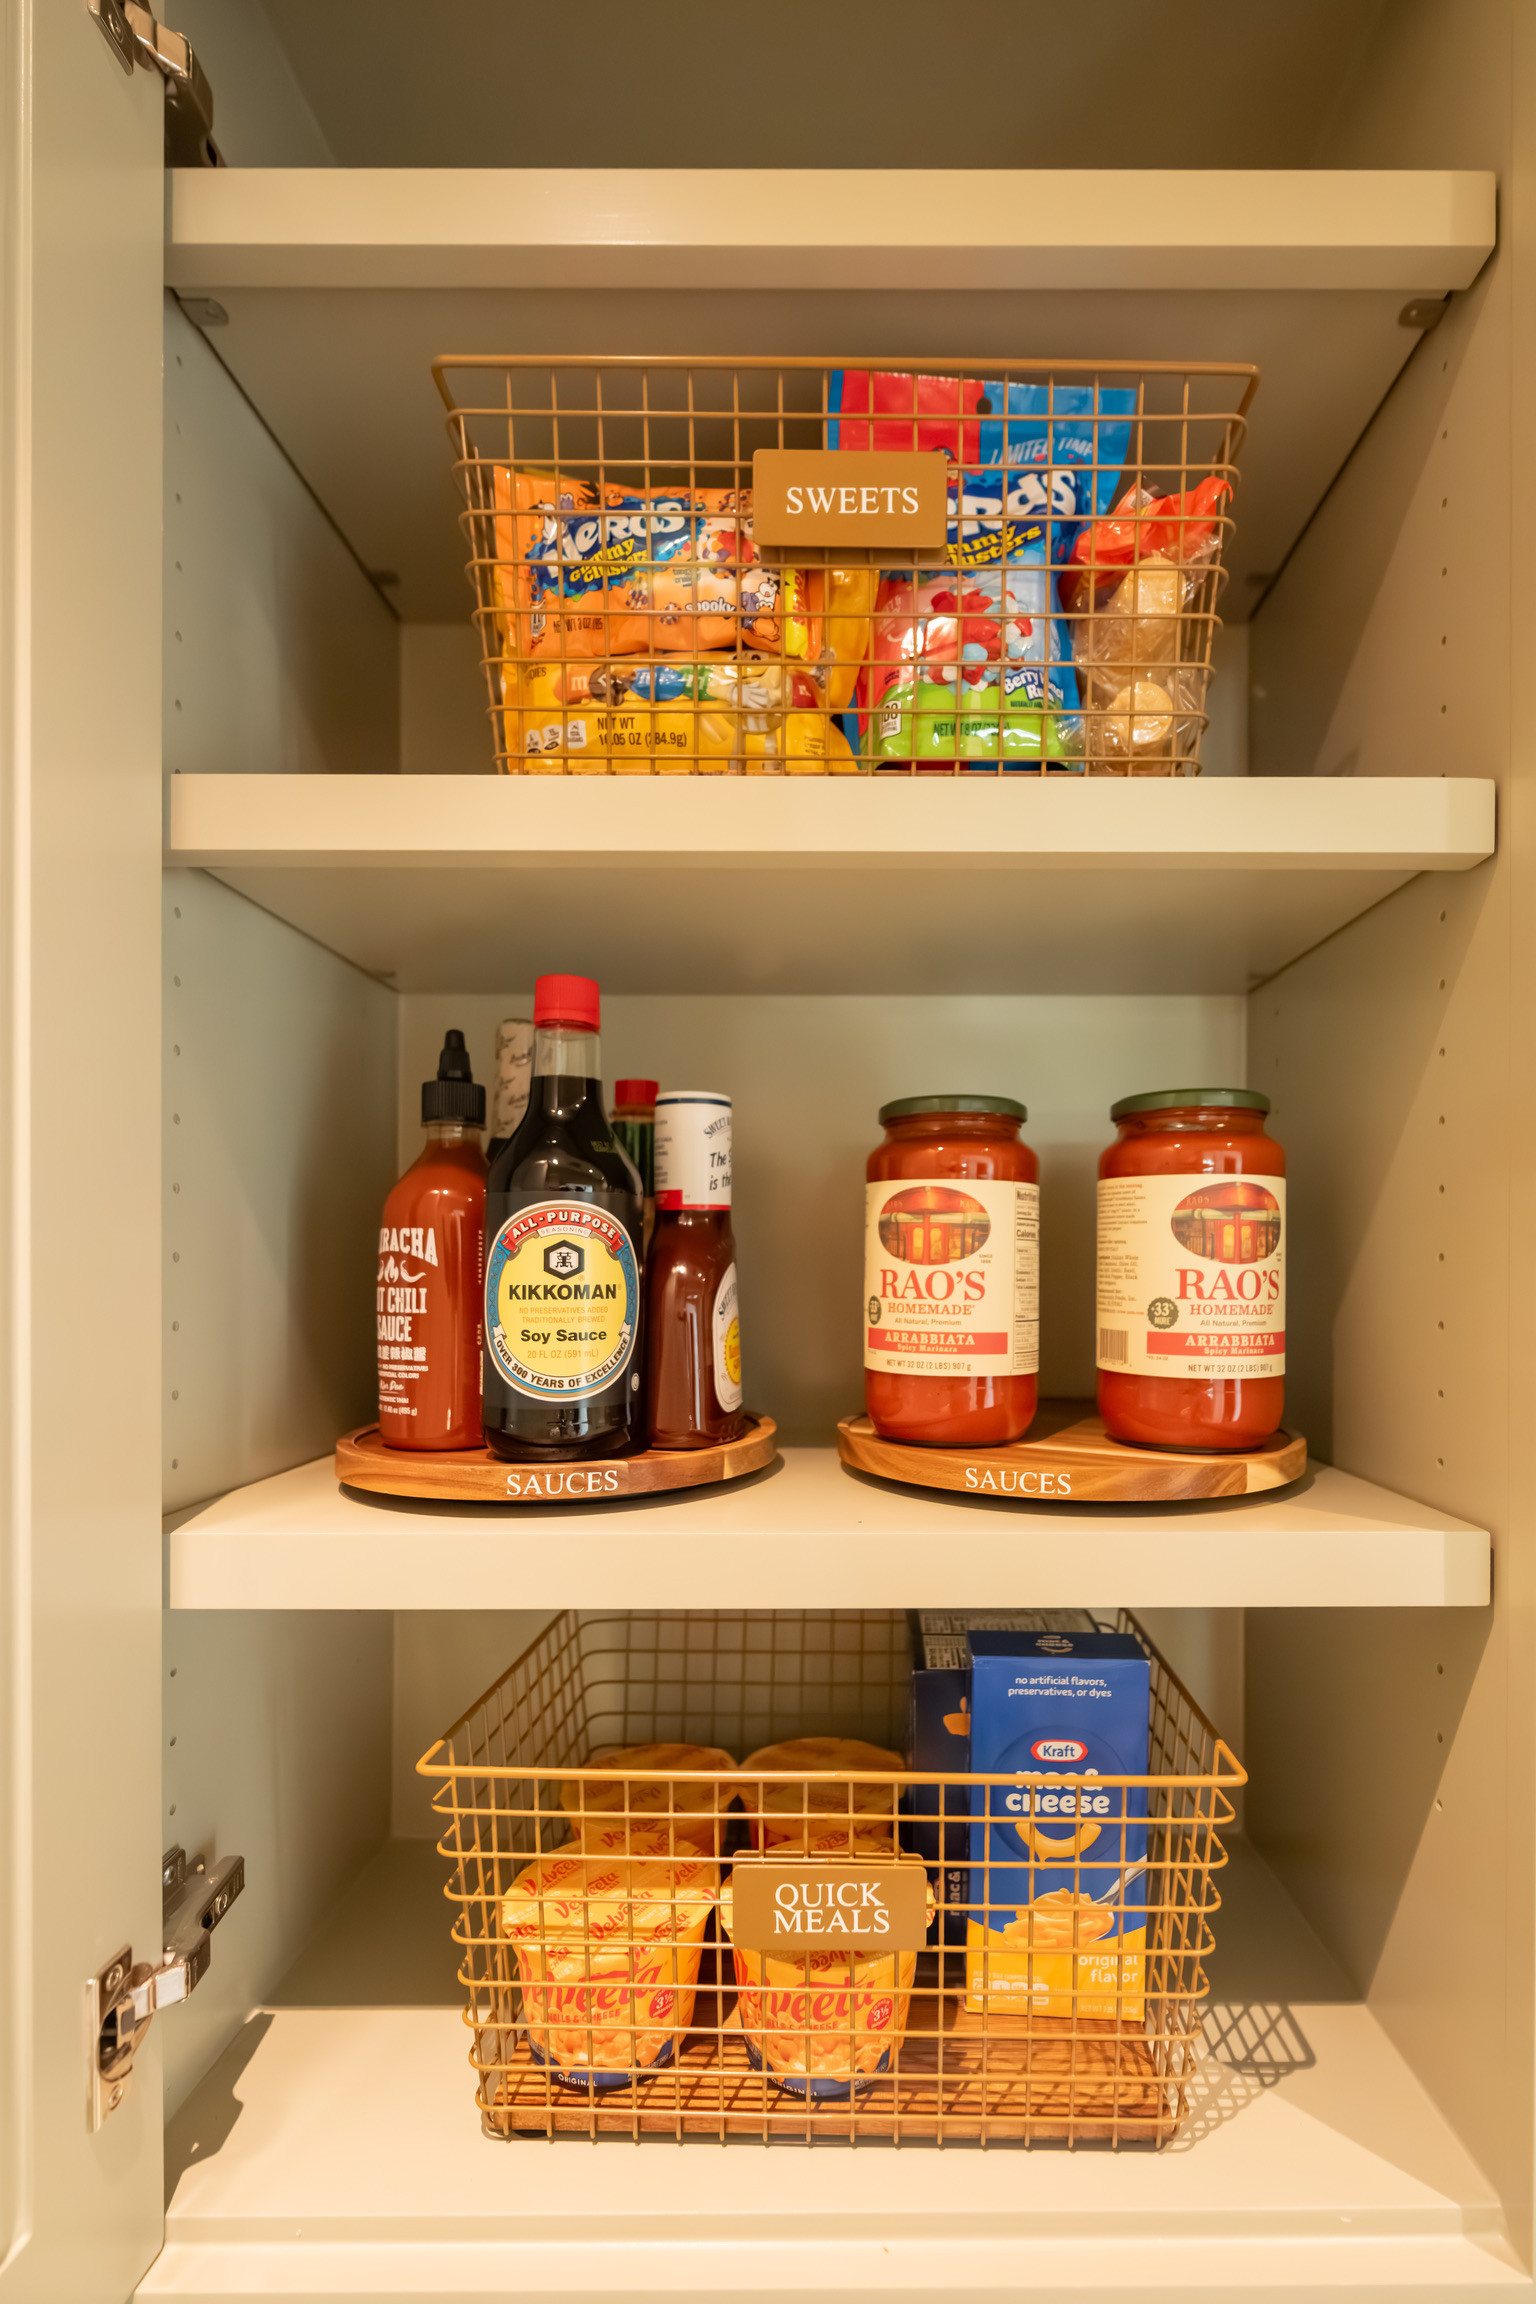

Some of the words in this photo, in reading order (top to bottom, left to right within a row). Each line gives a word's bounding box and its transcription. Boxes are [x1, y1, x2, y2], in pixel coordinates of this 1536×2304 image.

[786, 487, 919, 515] SWEETS
[1005, 670, 1039, 694] Berry
[619, 717, 636, 730] WT
[933, 721, 948, 736] NET
[629, 733, 642, 745] OZ
[709, 1152, 727, 1168] The
[709, 1175, 718, 1191] is
[511, 1210, 617, 1240] ALL-PURPOSE
[540, 1226, 589, 1236] SEASONING
[880, 1268, 986, 1301] RAO'S
[1175, 1268, 1280, 1301] RAO'S
[508, 1284, 617, 1301] KIKKOMAN
[387, 1287, 427, 1314] CHILI
[519, 1306, 529, 1315] NO
[530, 1306, 586, 1315] PRESERVATIVES
[587, 1306, 609, 1314] ADDED
[887, 1302, 973, 1315] HOMEMADE
[1189, 1304, 1273, 1316] HOMEMADE
[522, 1316, 575, 1324] TRADITIONALLY
[904, 1317, 930, 1326] Natural,
[931, 1318, 962, 1326] Premium
[1212, 1320, 1241, 1328] Natural,
[377, 1315, 412, 1342] SAUCE
[520, 1329, 551, 1345] Soy
[556, 1329, 607, 1342] Sauce
[885, 1331, 976, 1346] ARRABBIATA
[1185, 1334, 1275, 1347] ARRABBIATA
[527, 1350, 537, 1359] 20
[539, 1350, 548, 1359] FL
[550, 1350, 562, 1359] OZ
[564, 1349, 582, 1360] (591
[897, 1343, 917, 1353] Spicy
[920, 1344, 958, 1353] Marinara
[1204, 1347, 1228, 1356] Spicy
[1230, 1347, 1264, 1355] Marinara
[496, 1340, 512, 1366] OVER
[511, 1363, 529, 1379] 300
[531, 1373, 565, 1389] YEARS
[568, 1378, 582, 1388] OF
[585, 1336, 629, 1384] EXCELLENCE
[897, 1359, 906, 1367] WT
[907, 1360, 915, 1368] 32
[916, 1361, 925, 1369] OZ
[926, 1361, 933, 1370] (2
[934, 1361, 951, 1370] LBS)
[952, 1362, 965, 1370] 907
[966, 1363, 972, 1372] g
[1188, 1364, 1201, 1372] NET
[1203, 1364, 1215, 1372] WT
[1216, 1364, 1225, 1372] 32
[1227, 1364, 1237, 1372] OZ
[1237, 1364, 1245, 1373] (2
[1245, 1364, 1260, 1372] LBS)
[506, 1469, 619, 1496] SAUCES
[965, 1467, 1072, 1495] SAUCES
[1029, 1675, 1069, 1685] artificial
[1070, 1676, 1108, 1687] flavors,
[1008, 1686, 1075, 1698] preservatives,
[1076, 1689, 1088, 1697] or
[1089, 1688, 1112, 1698] dyes
[1043, 1745, 1075, 1758] Kraft
[1005, 1793, 1111, 1814] cheese
[775, 1883, 885, 1911] QUICK
[773, 1908, 890, 1934] MEALS
[1078, 1955, 1139, 1970] origial
[1090, 1969, 1138, 1983] flavor
